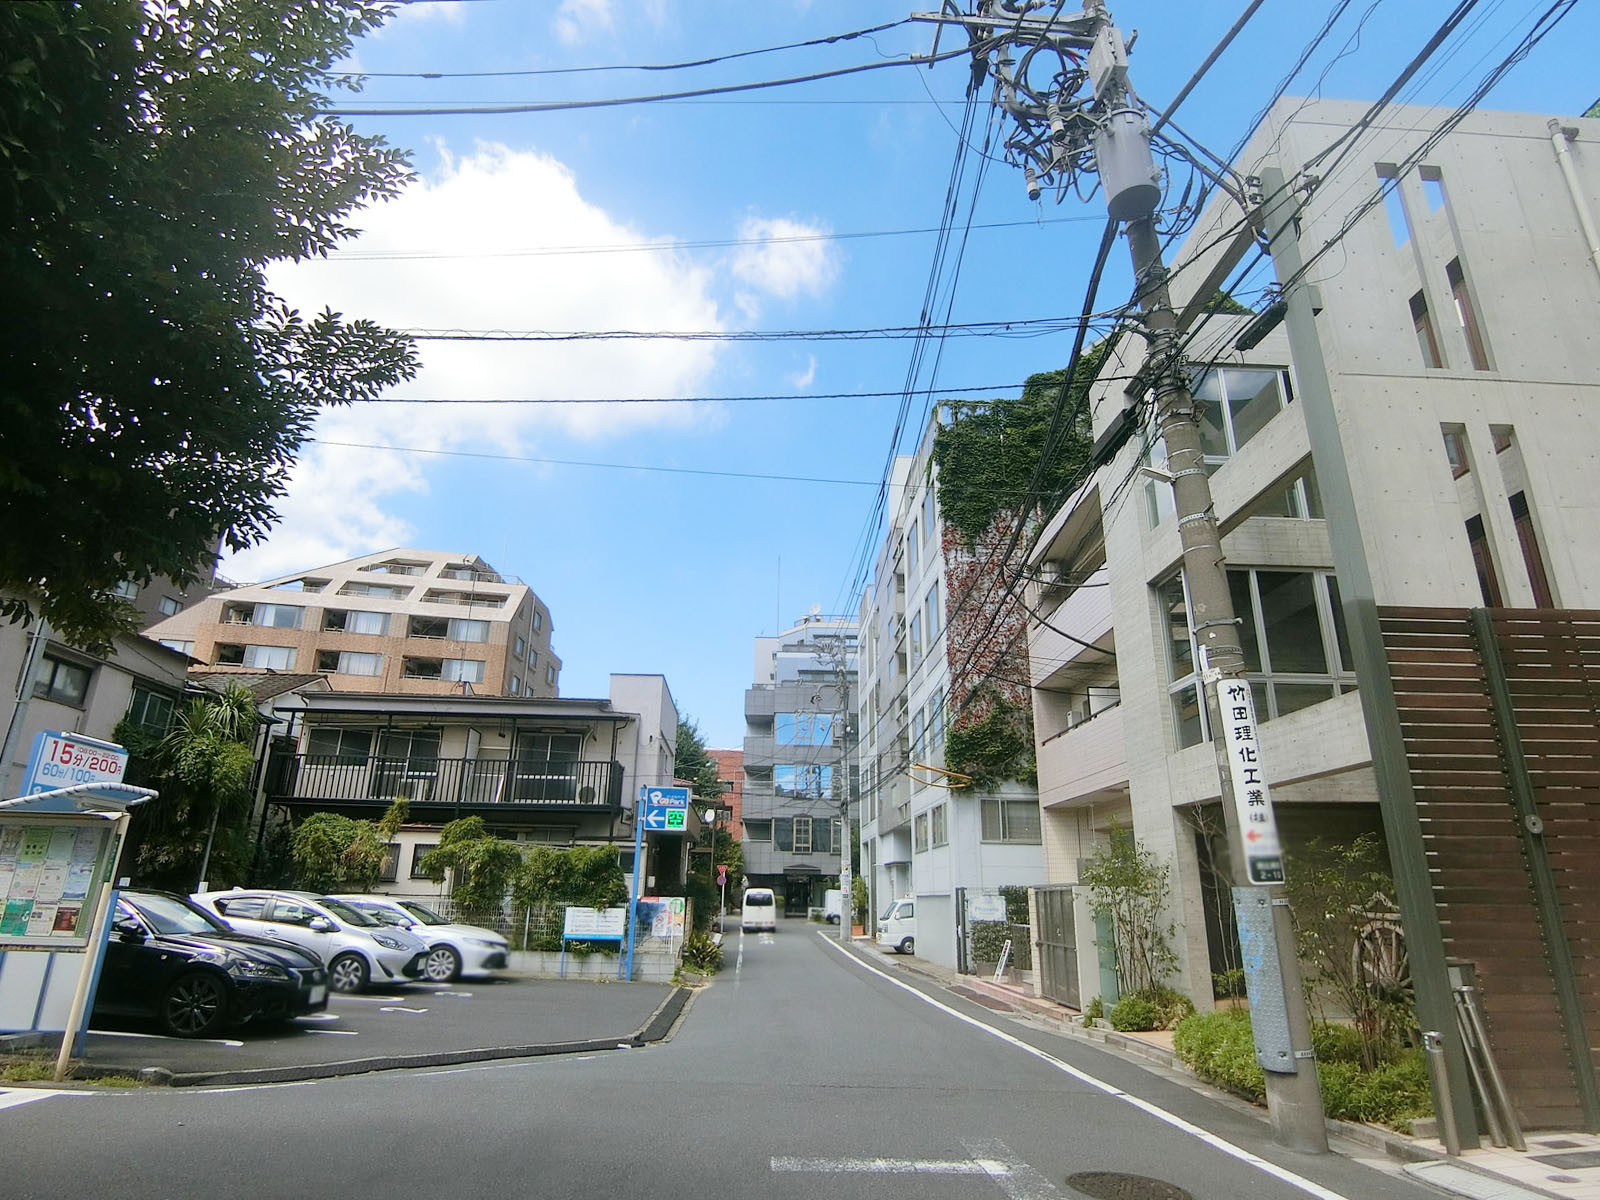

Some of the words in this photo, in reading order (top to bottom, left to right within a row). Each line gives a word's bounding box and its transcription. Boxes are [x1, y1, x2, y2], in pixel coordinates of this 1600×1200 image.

[1227, 685, 1265, 807] 竹田理化工業
